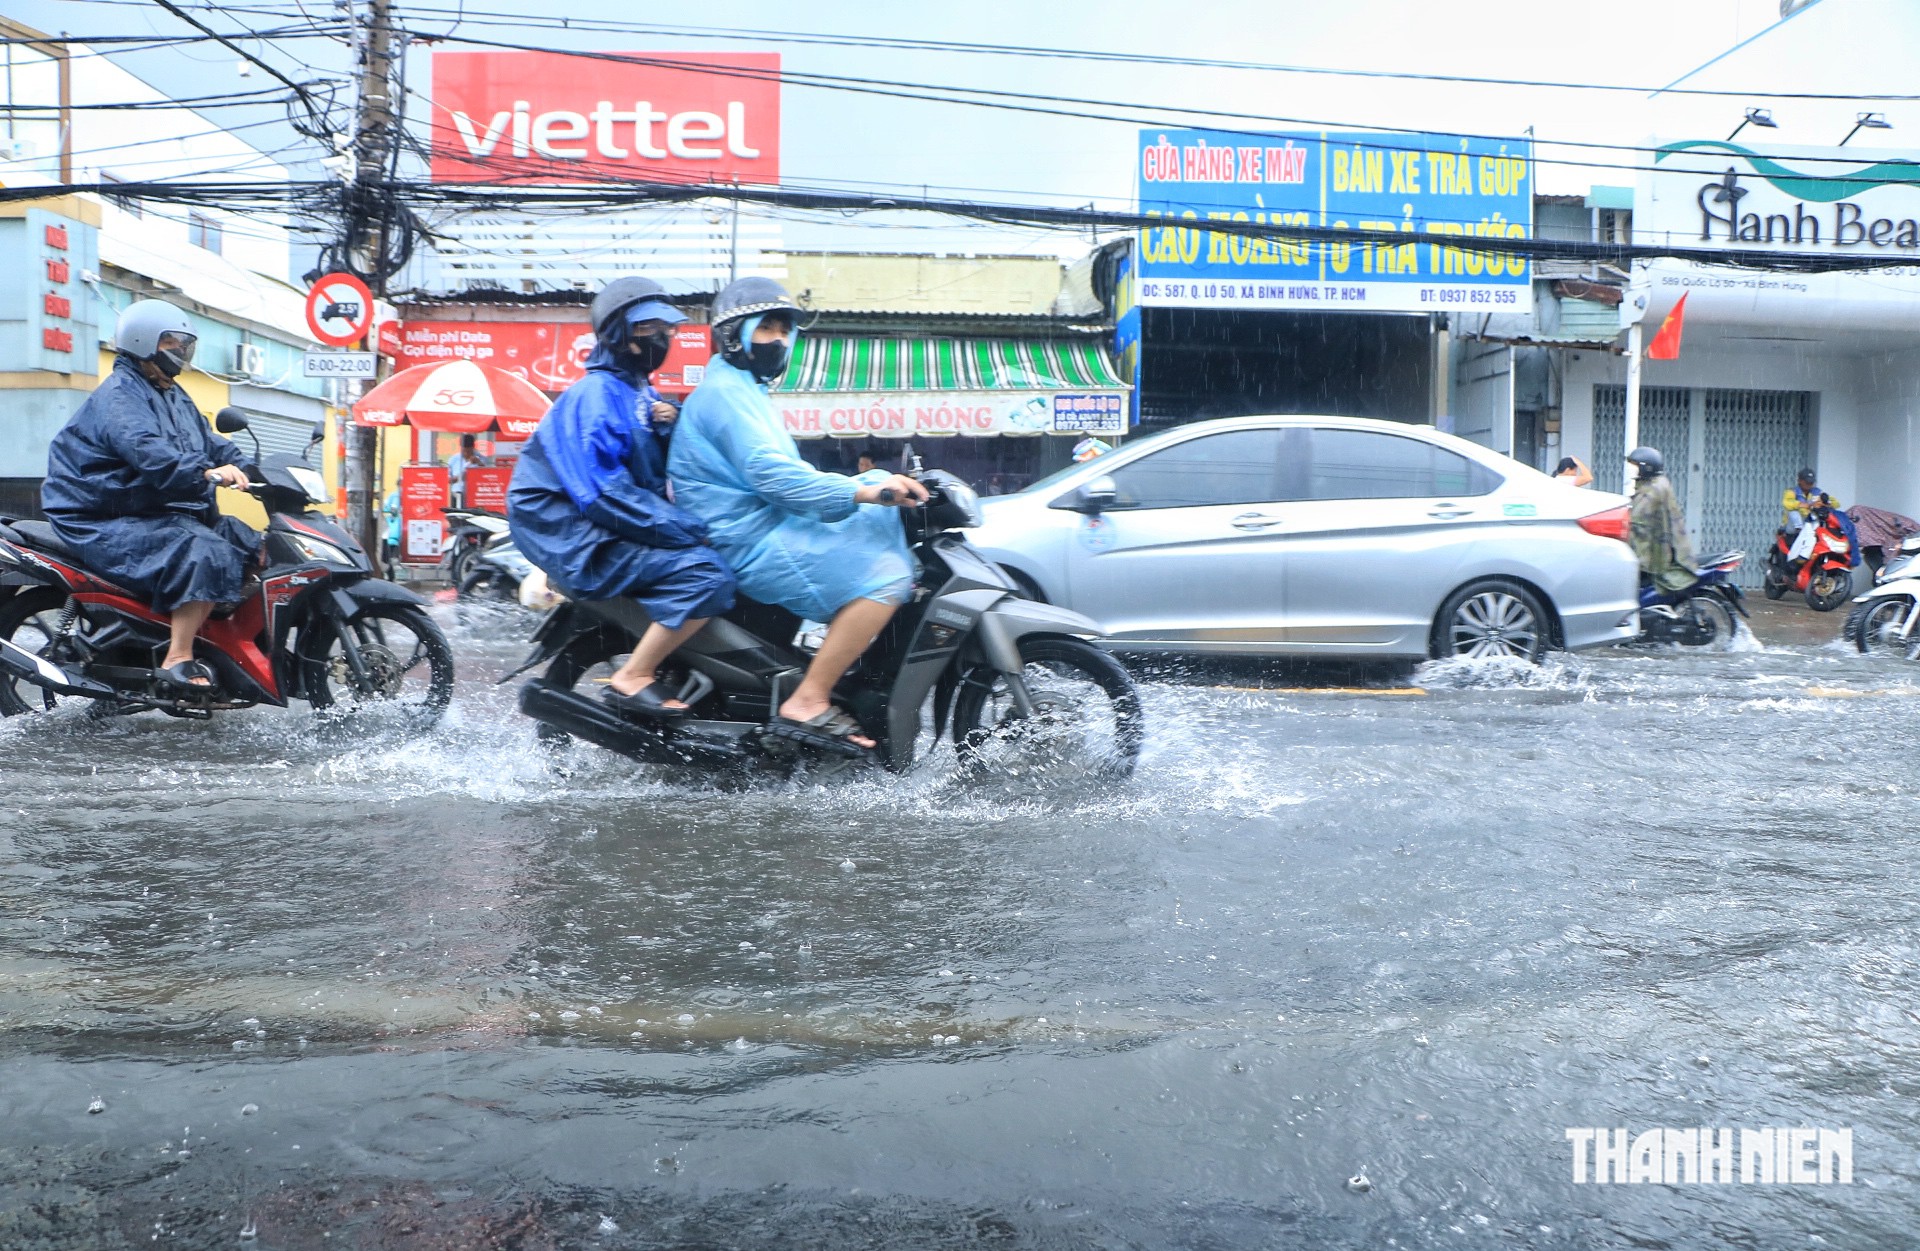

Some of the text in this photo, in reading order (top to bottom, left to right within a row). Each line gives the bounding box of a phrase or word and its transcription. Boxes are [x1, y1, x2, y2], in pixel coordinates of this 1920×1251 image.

[451, 101, 760, 158] viettel
[1144, 134, 1307, 184] CỬA HÀNG XE MÁY
[1333, 138, 1526, 196] BÁN XE TRẢ GÓP
[1141, 193, 1309, 266] CAO HOÀNG
[1358, 203, 1418, 274] TRẢ
[1426, 212, 1526, 276] TRƯỚC
[1662, 277, 1679, 286] 589
[1143, 284, 1161, 297] ĐC:
[1325, 287, 1337, 300] TP.
[1341, 287, 1366, 300] HCM
[1420, 289, 1516, 304] ĐT: 0937 852 555
[405, 328, 438, 342] Miễn
[440, 330, 459, 343] phí
[461, 331, 492, 343] Data
[402, 344, 425, 357] Gọi
[426, 344, 453, 358] điện
[477, 346, 495, 359] ga
[434, 390, 474, 406] 5G
[362, 410, 396, 424] viettel
[782, 397, 993, 431] NH CUỐN NÓNG
